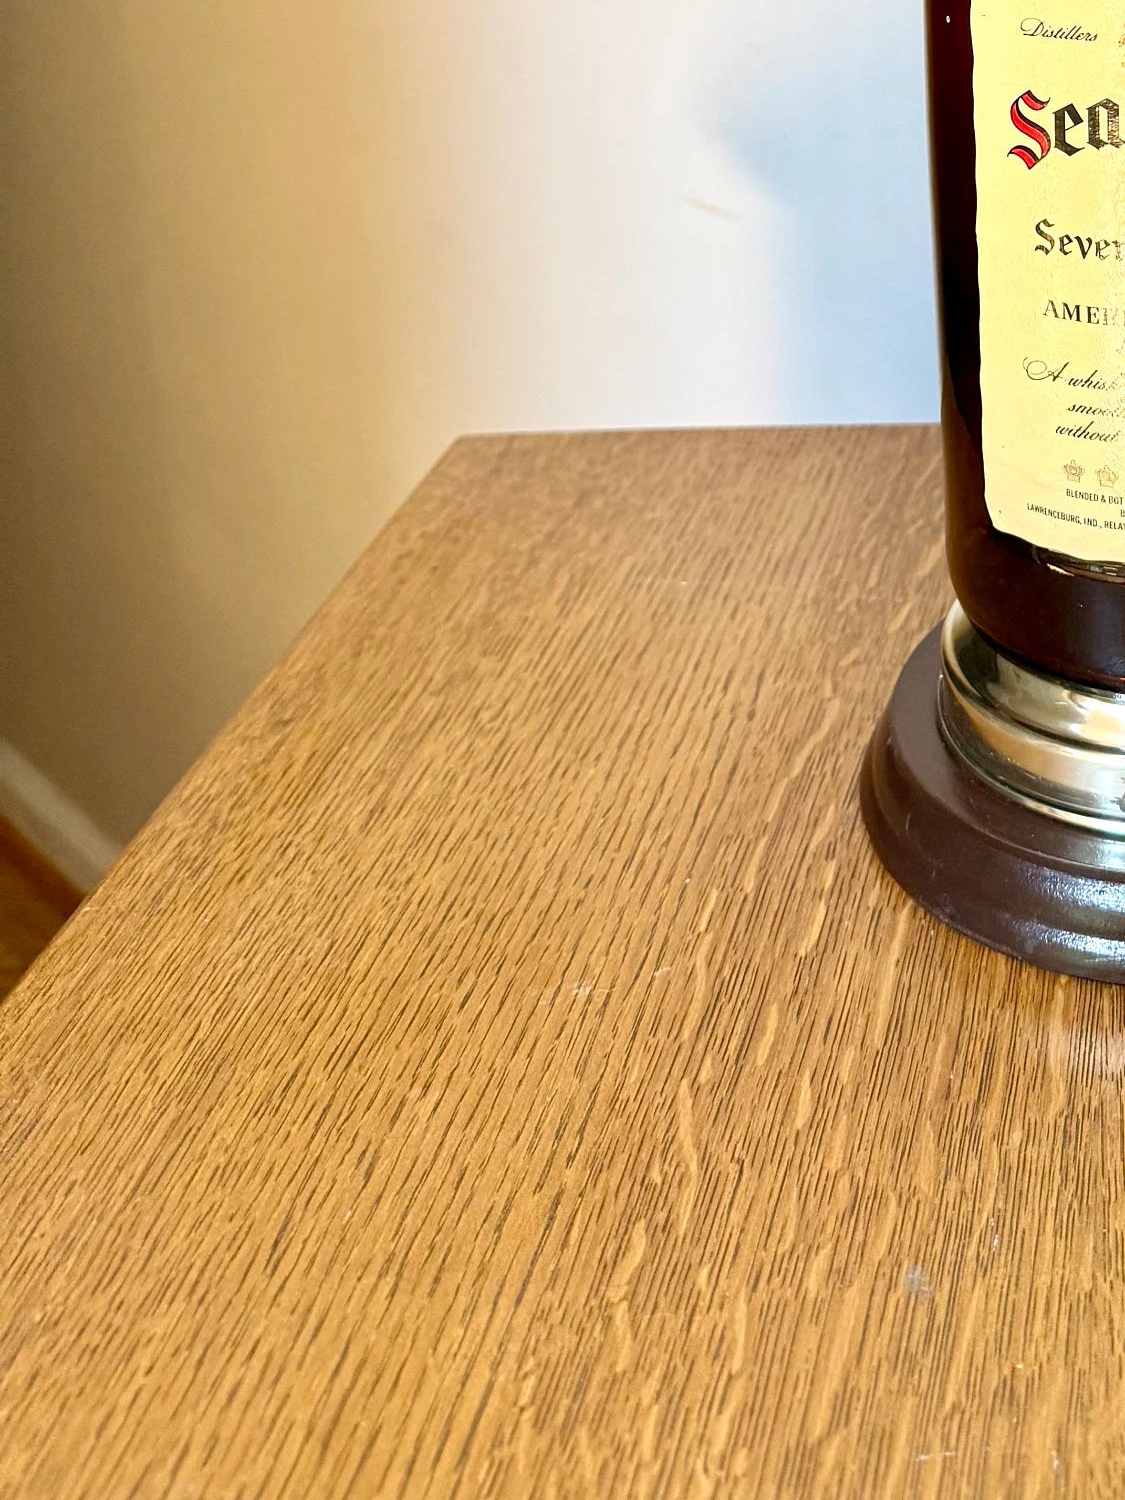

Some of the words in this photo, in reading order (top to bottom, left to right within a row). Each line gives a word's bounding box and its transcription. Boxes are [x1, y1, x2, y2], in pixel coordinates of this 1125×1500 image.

[1020, 17, 1098, 43] Distillers
[1022, 356, 1070, 382] A
[1055, 421, 1119, 443] without
[1066, 488, 1099, 502] BLENDED
[1100, 494, 1107, 503] &
[1027, 502, 1082, 525] LAWRENCEBURG,
